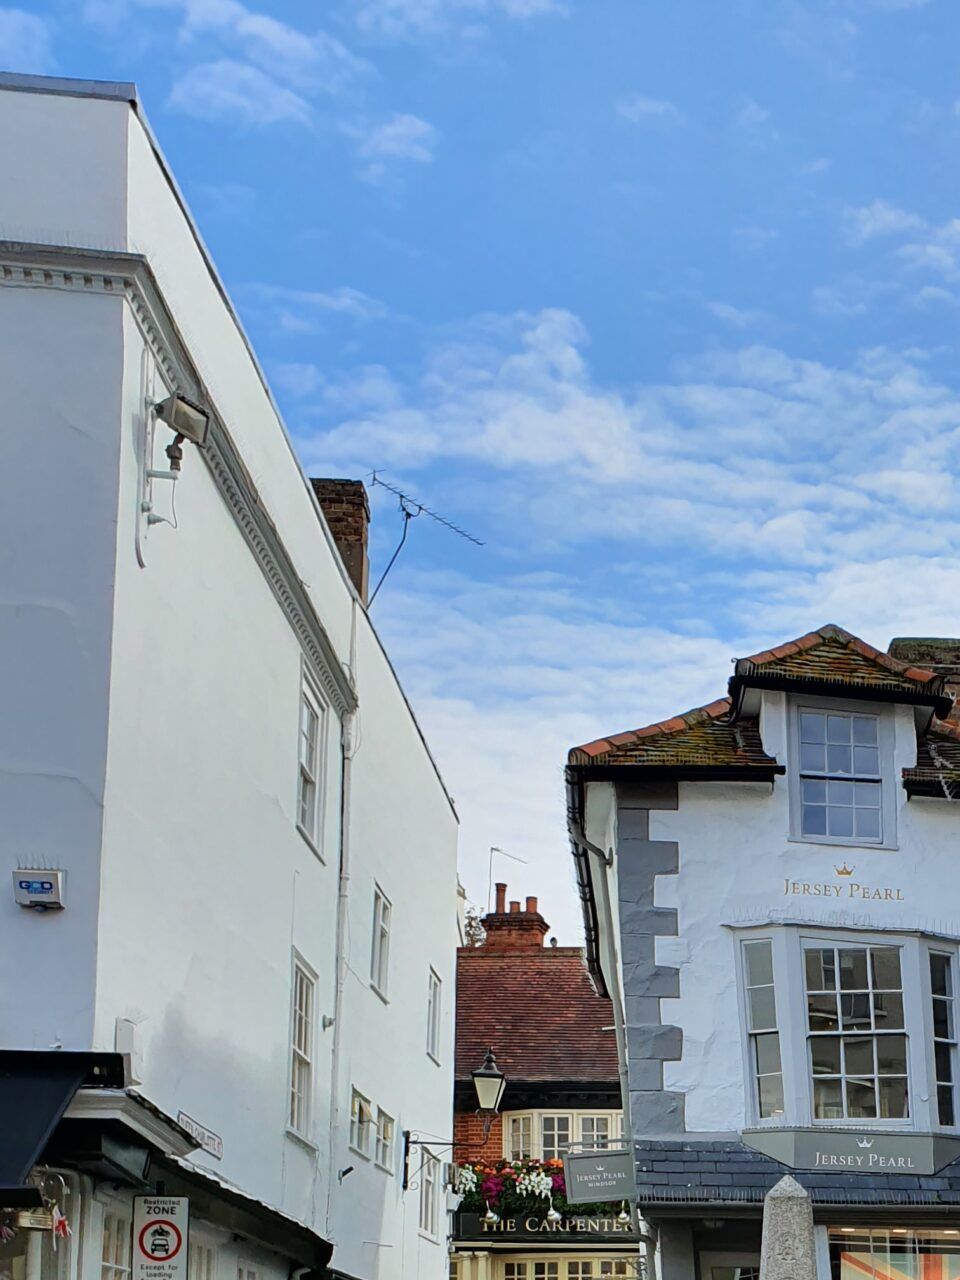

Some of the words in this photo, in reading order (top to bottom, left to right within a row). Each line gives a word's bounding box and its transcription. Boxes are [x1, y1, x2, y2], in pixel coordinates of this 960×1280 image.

[783, 879, 842, 897] JERSEY
[848, 883, 905, 901] PEARL
[815, 1152, 864, 1167] JERSEY
[868, 1153, 915, 1168] PEARL
[576, 1174, 601, 1183] JERSEY
[603, 1171, 627, 1179] PEARL
[588, 1180, 617, 1188] WINDSOR
[143, 1198, 181, 1206] Restricted
[146, 1205, 177, 1216] ZONE
[479, 1217, 517, 1232] THE
[140, 1263, 165, 1272] Except
[168, 1263, 179, 1271] for
[146, 1271, 173, 1280] loading
